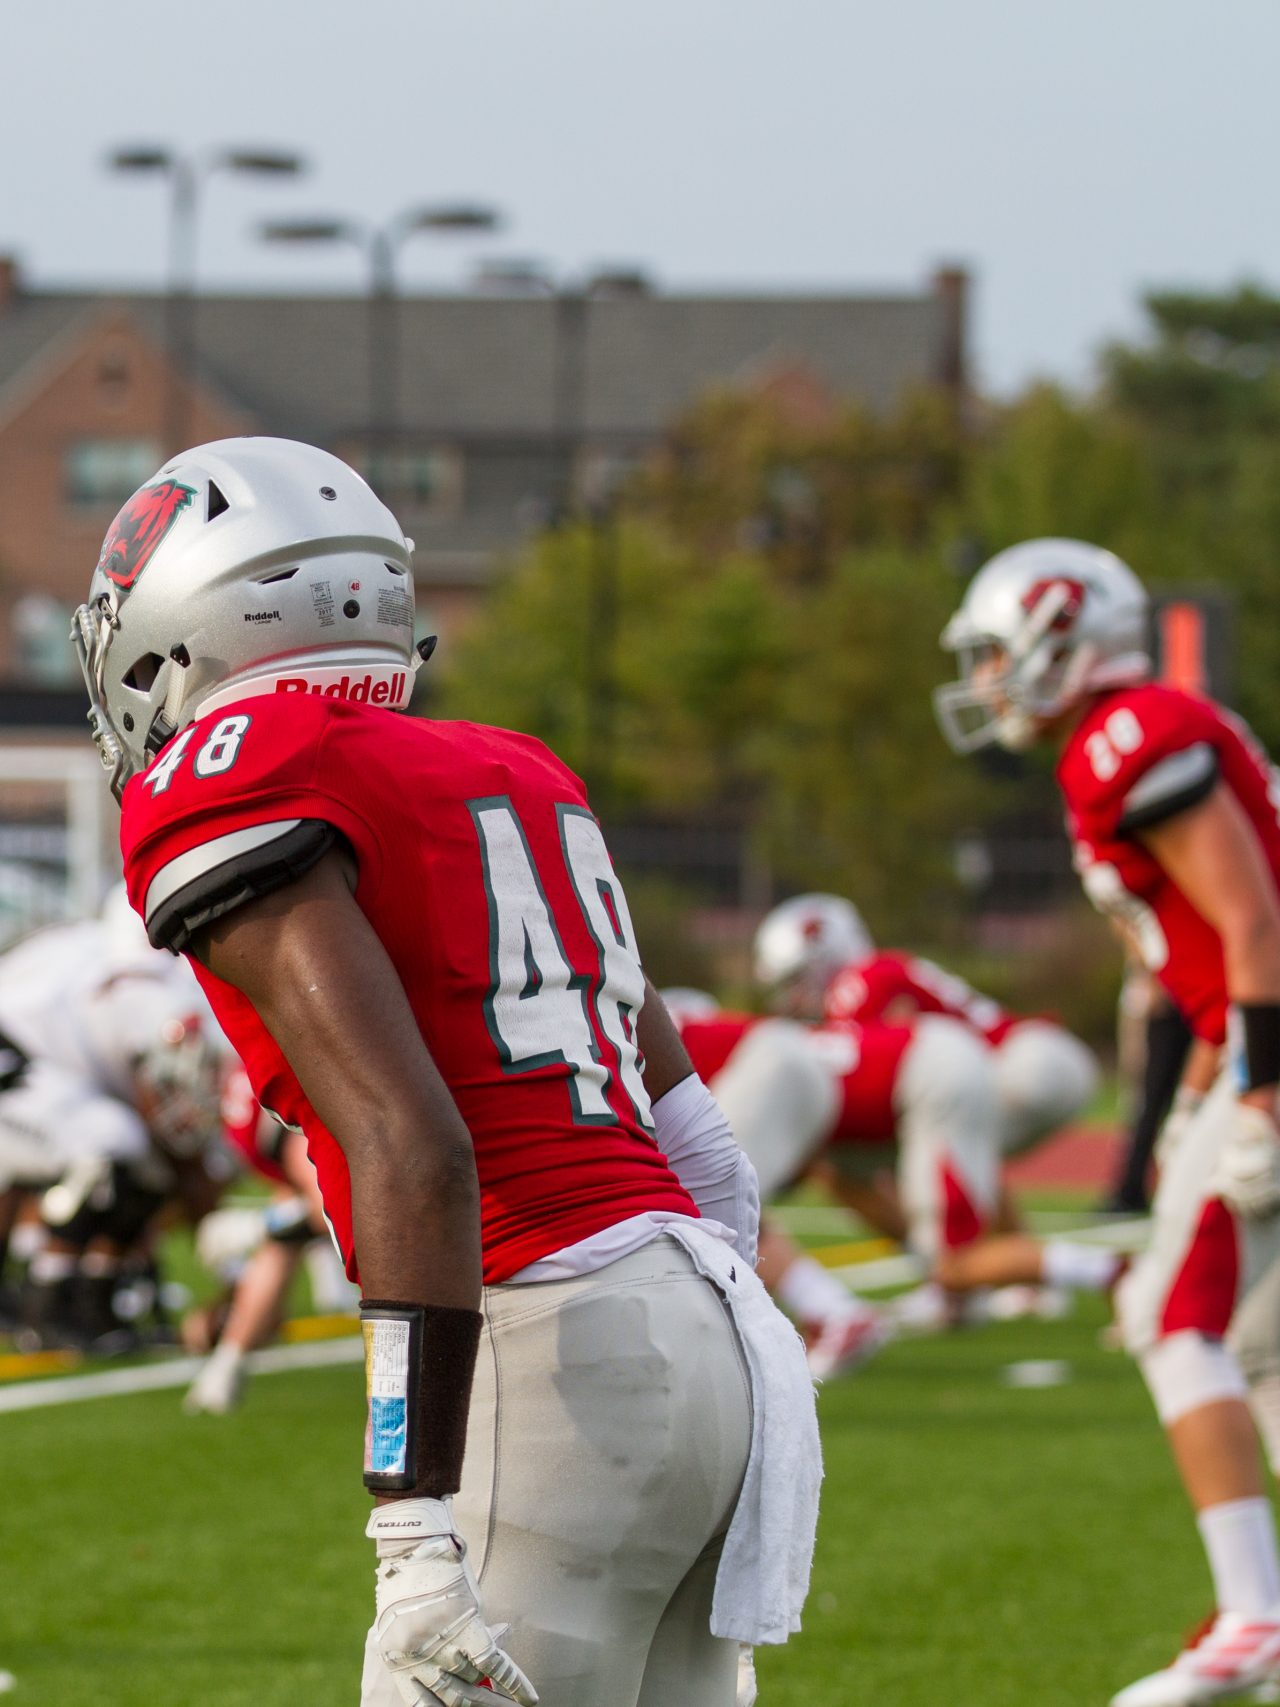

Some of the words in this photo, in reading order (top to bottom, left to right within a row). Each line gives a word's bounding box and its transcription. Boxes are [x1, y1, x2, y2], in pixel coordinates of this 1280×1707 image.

[351, 583, 360, 591] 48
[244, 611, 280, 622] Riddell
[141, 713, 253, 800] 48
[464, 794, 658, 1143] 48
[377, 1520, 422, 1528] CUTTERS
